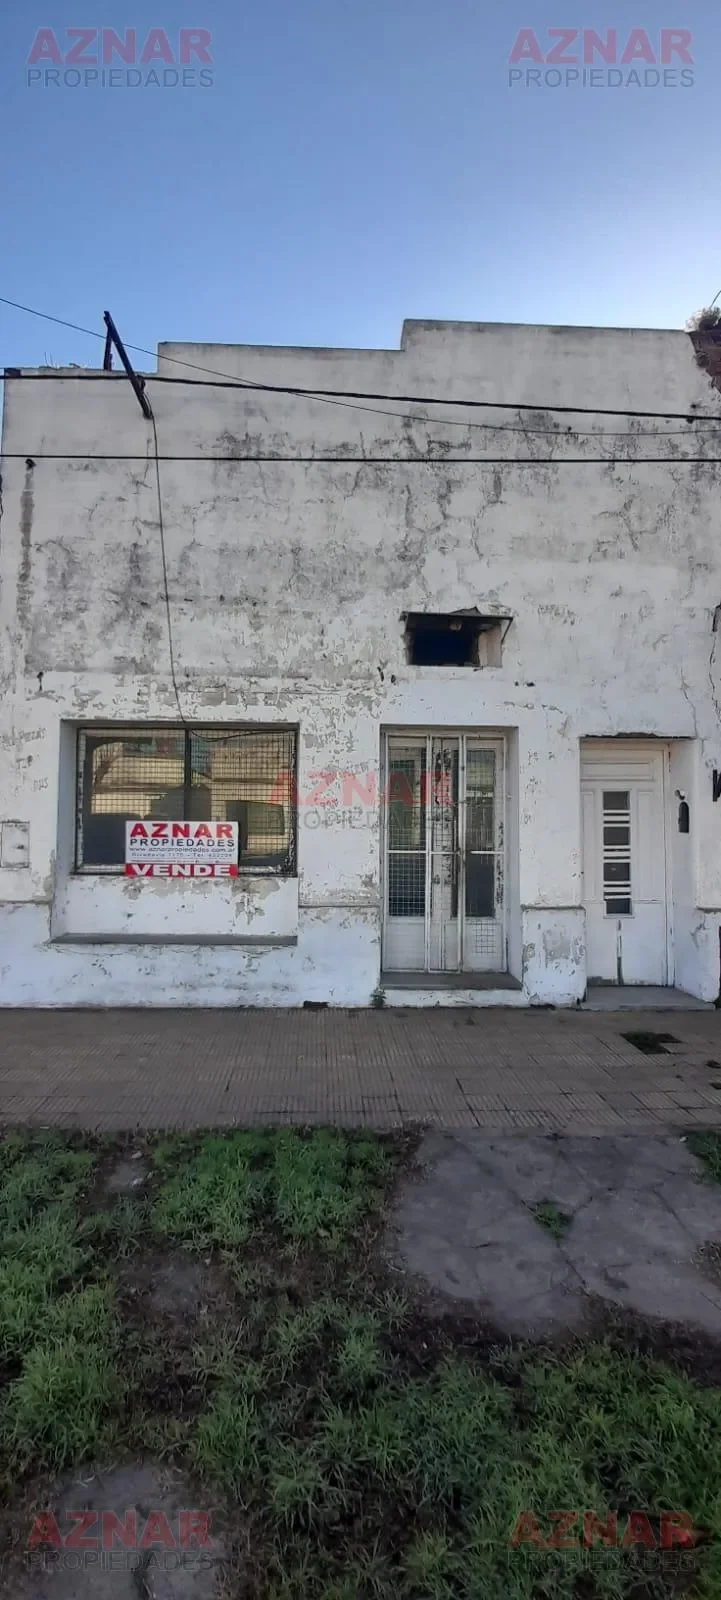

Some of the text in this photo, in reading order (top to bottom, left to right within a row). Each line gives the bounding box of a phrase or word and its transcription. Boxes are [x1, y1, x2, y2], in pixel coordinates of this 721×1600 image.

[130, 823, 233, 838] AZNAR
[130, 839, 234, 847] PROPIEDADES
[132, 864, 231, 876] VENDE
